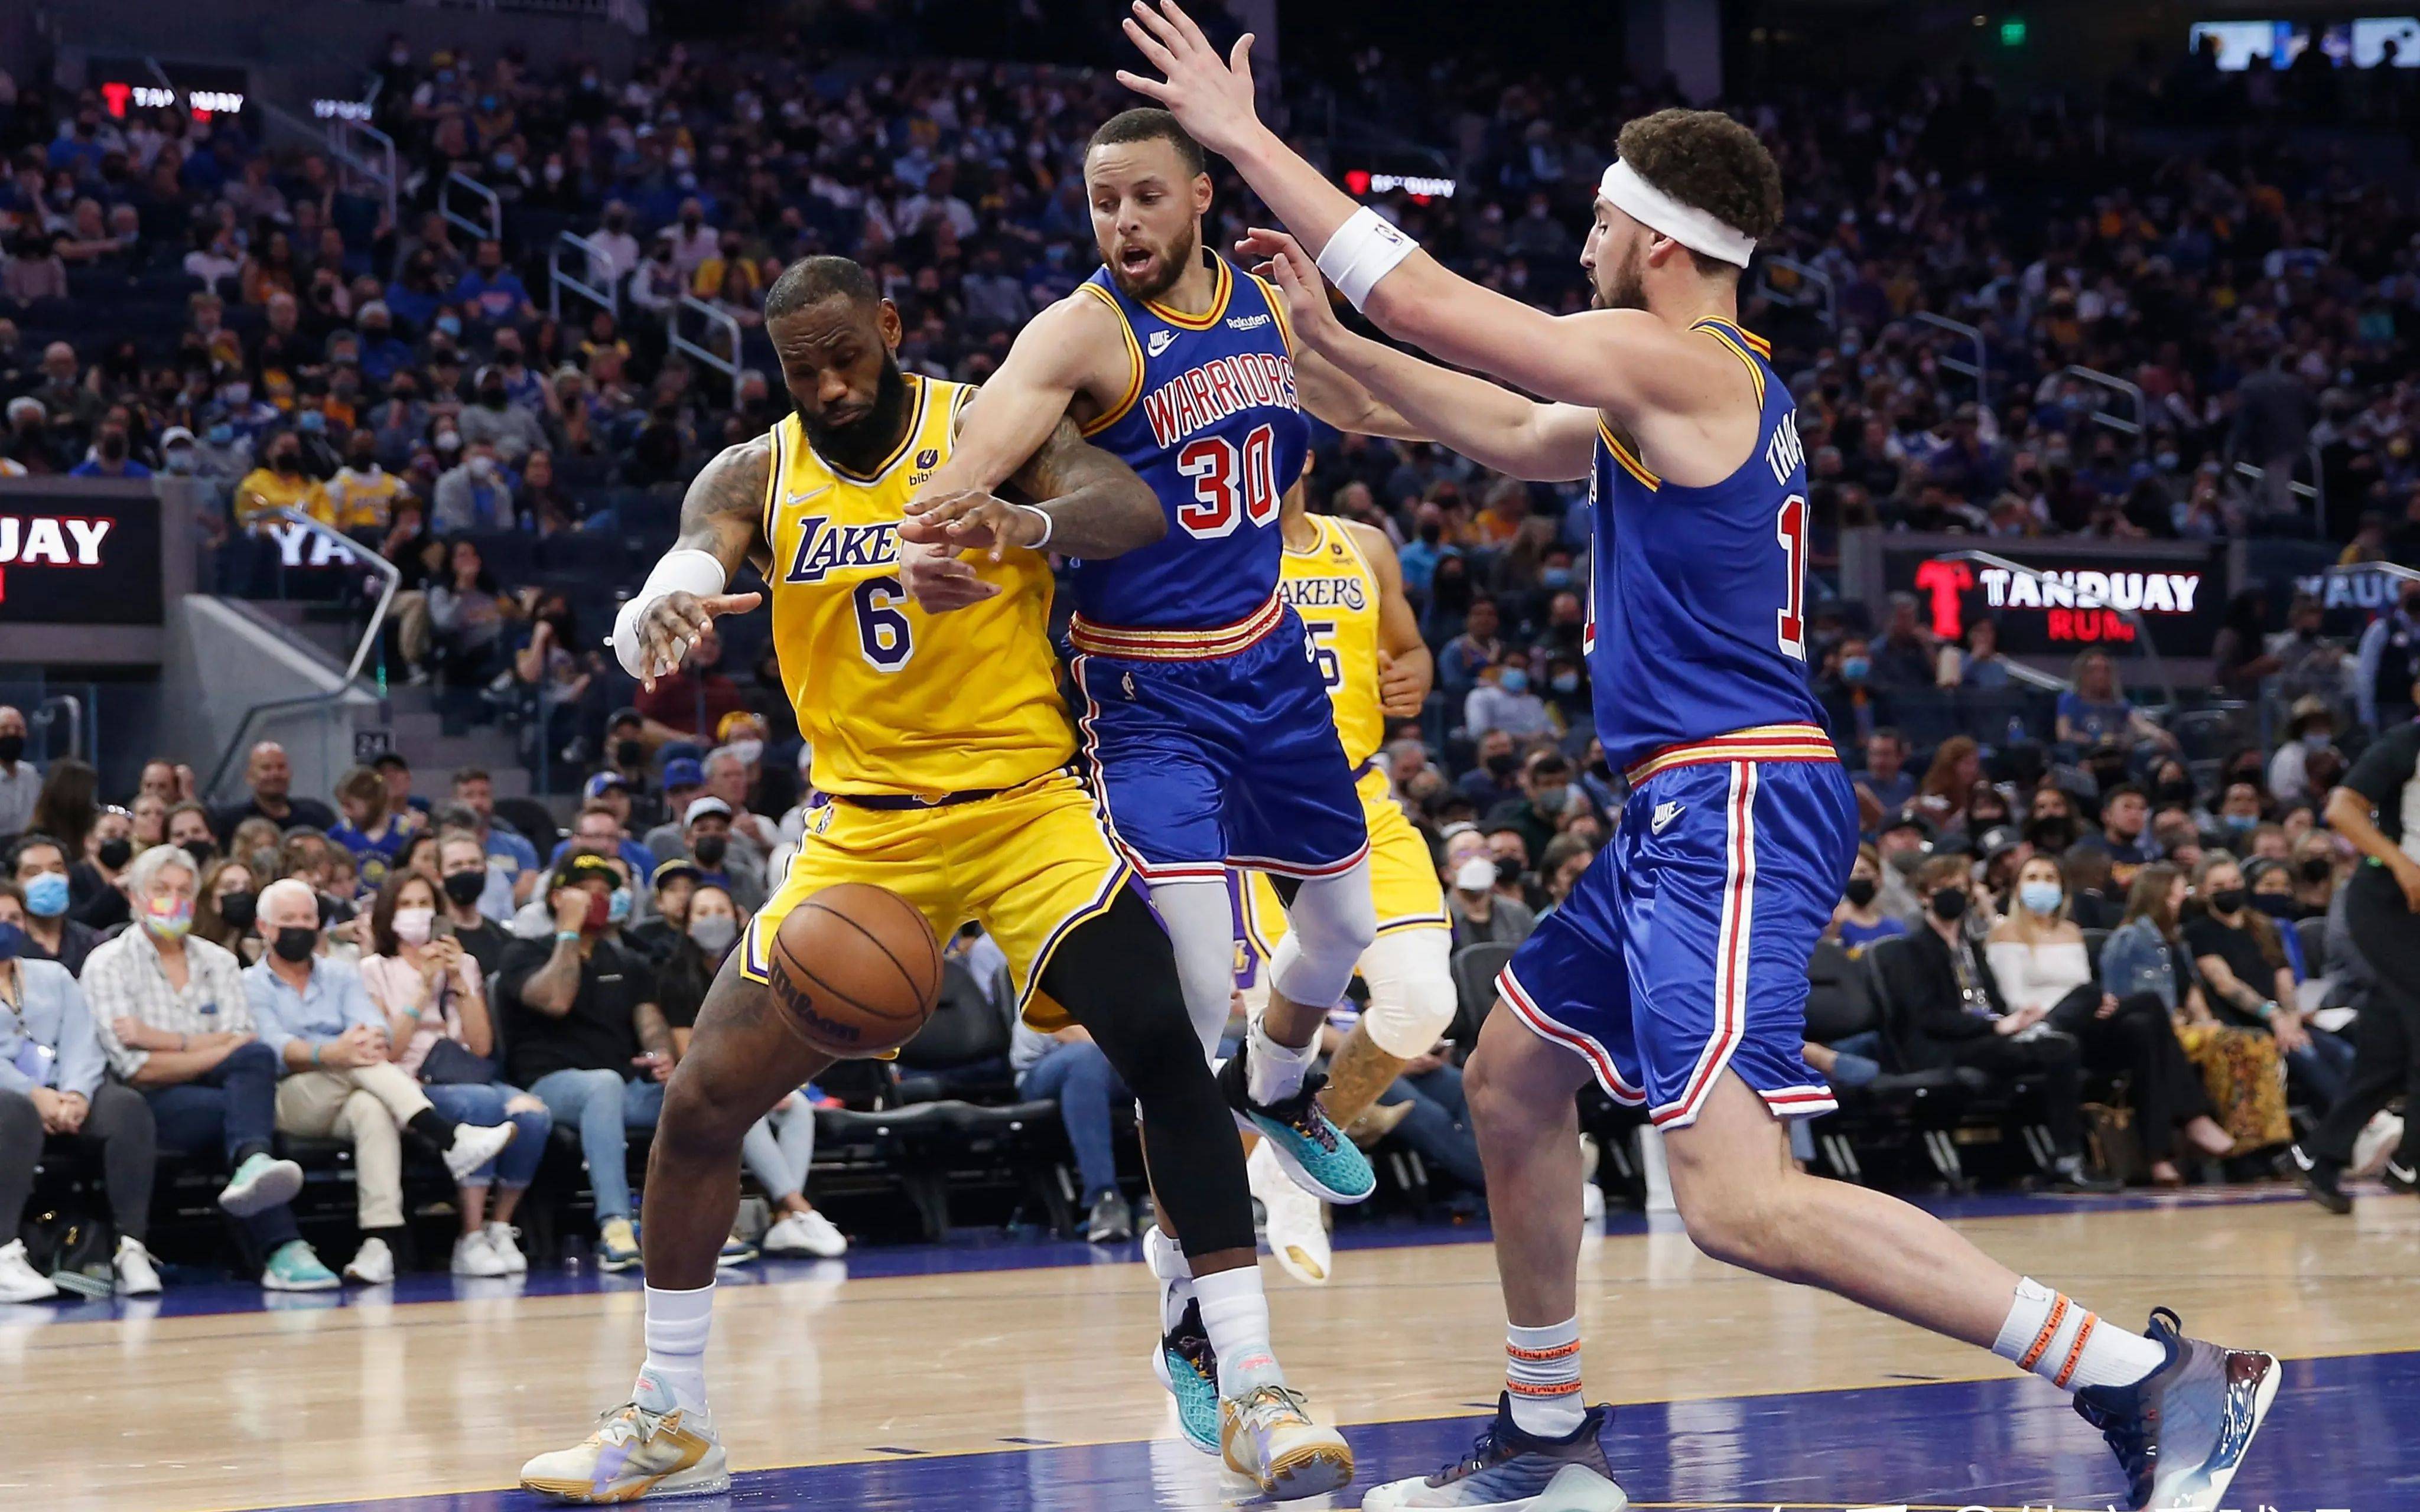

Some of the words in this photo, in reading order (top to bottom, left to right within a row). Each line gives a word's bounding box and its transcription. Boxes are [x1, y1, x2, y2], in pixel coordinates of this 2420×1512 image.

[1149, 330, 1170, 347] NIKE
[1226, 314, 1270, 330] Rakuten
[1143, 353, 1299, 450] WARRIORS
[1177, 423, 1280, 540] 30
[785, 515, 903, 585] LAKE
[852, 575, 915, 673] 6
[1277, 577, 1366, 614] AKERS
[1979, 568, 2200, 612] TANDUAY
[1306, 621, 1345, 694] 5
